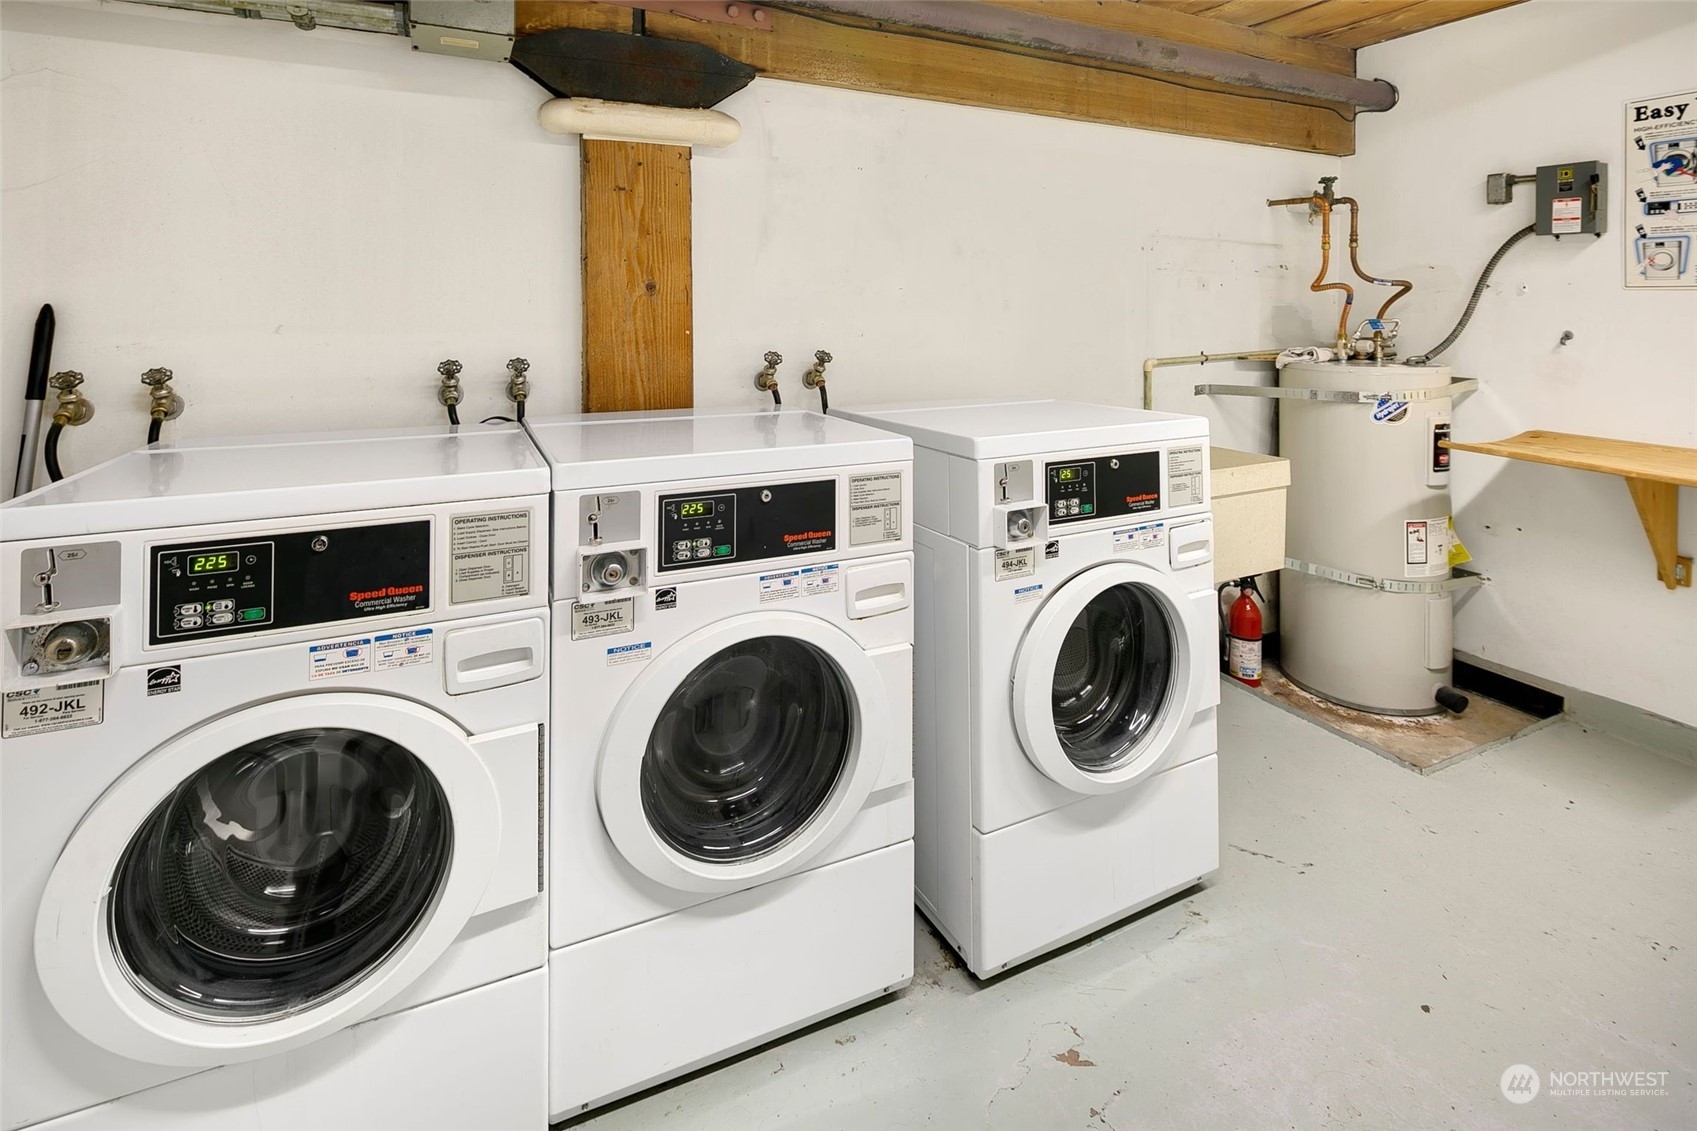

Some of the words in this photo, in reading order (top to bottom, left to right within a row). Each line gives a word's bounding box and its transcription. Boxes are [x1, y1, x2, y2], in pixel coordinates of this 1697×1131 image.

[1634, 103, 1690, 122] Easy
[1634, 119, 1697, 132] HIGH-EFFICIENC
[1061, 470, 1070, 478] 25
[682, 504, 704, 514] 225
[454, 516, 486, 525] OPERATING
[488, 513, 528, 522] INSTRUCTIONS
[784, 532, 807, 542] Speed
[808, 530, 831, 538] Queen
[454, 552, 486, 560] DISPENSER
[488, 548, 528, 557] INSTRUCTIONS
[194, 556, 227, 570] 225
[1002, 558, 1028, 568] 494-JKL
[349, 588, 386, 602] Speed
[387, 585, 423, 596] Queen
[354, 597, 392, 608] Commercial
[393, 594, 416, 603] Washer
[582, 612, 624, 624] 493-JKL
[316, 640, 364, 651] ADVERTENCIA
[613, 643, 646, 653] NOTICE
[6, 690, 32, 698] CSC
[20, 698, 86, 716] 492-JKL
